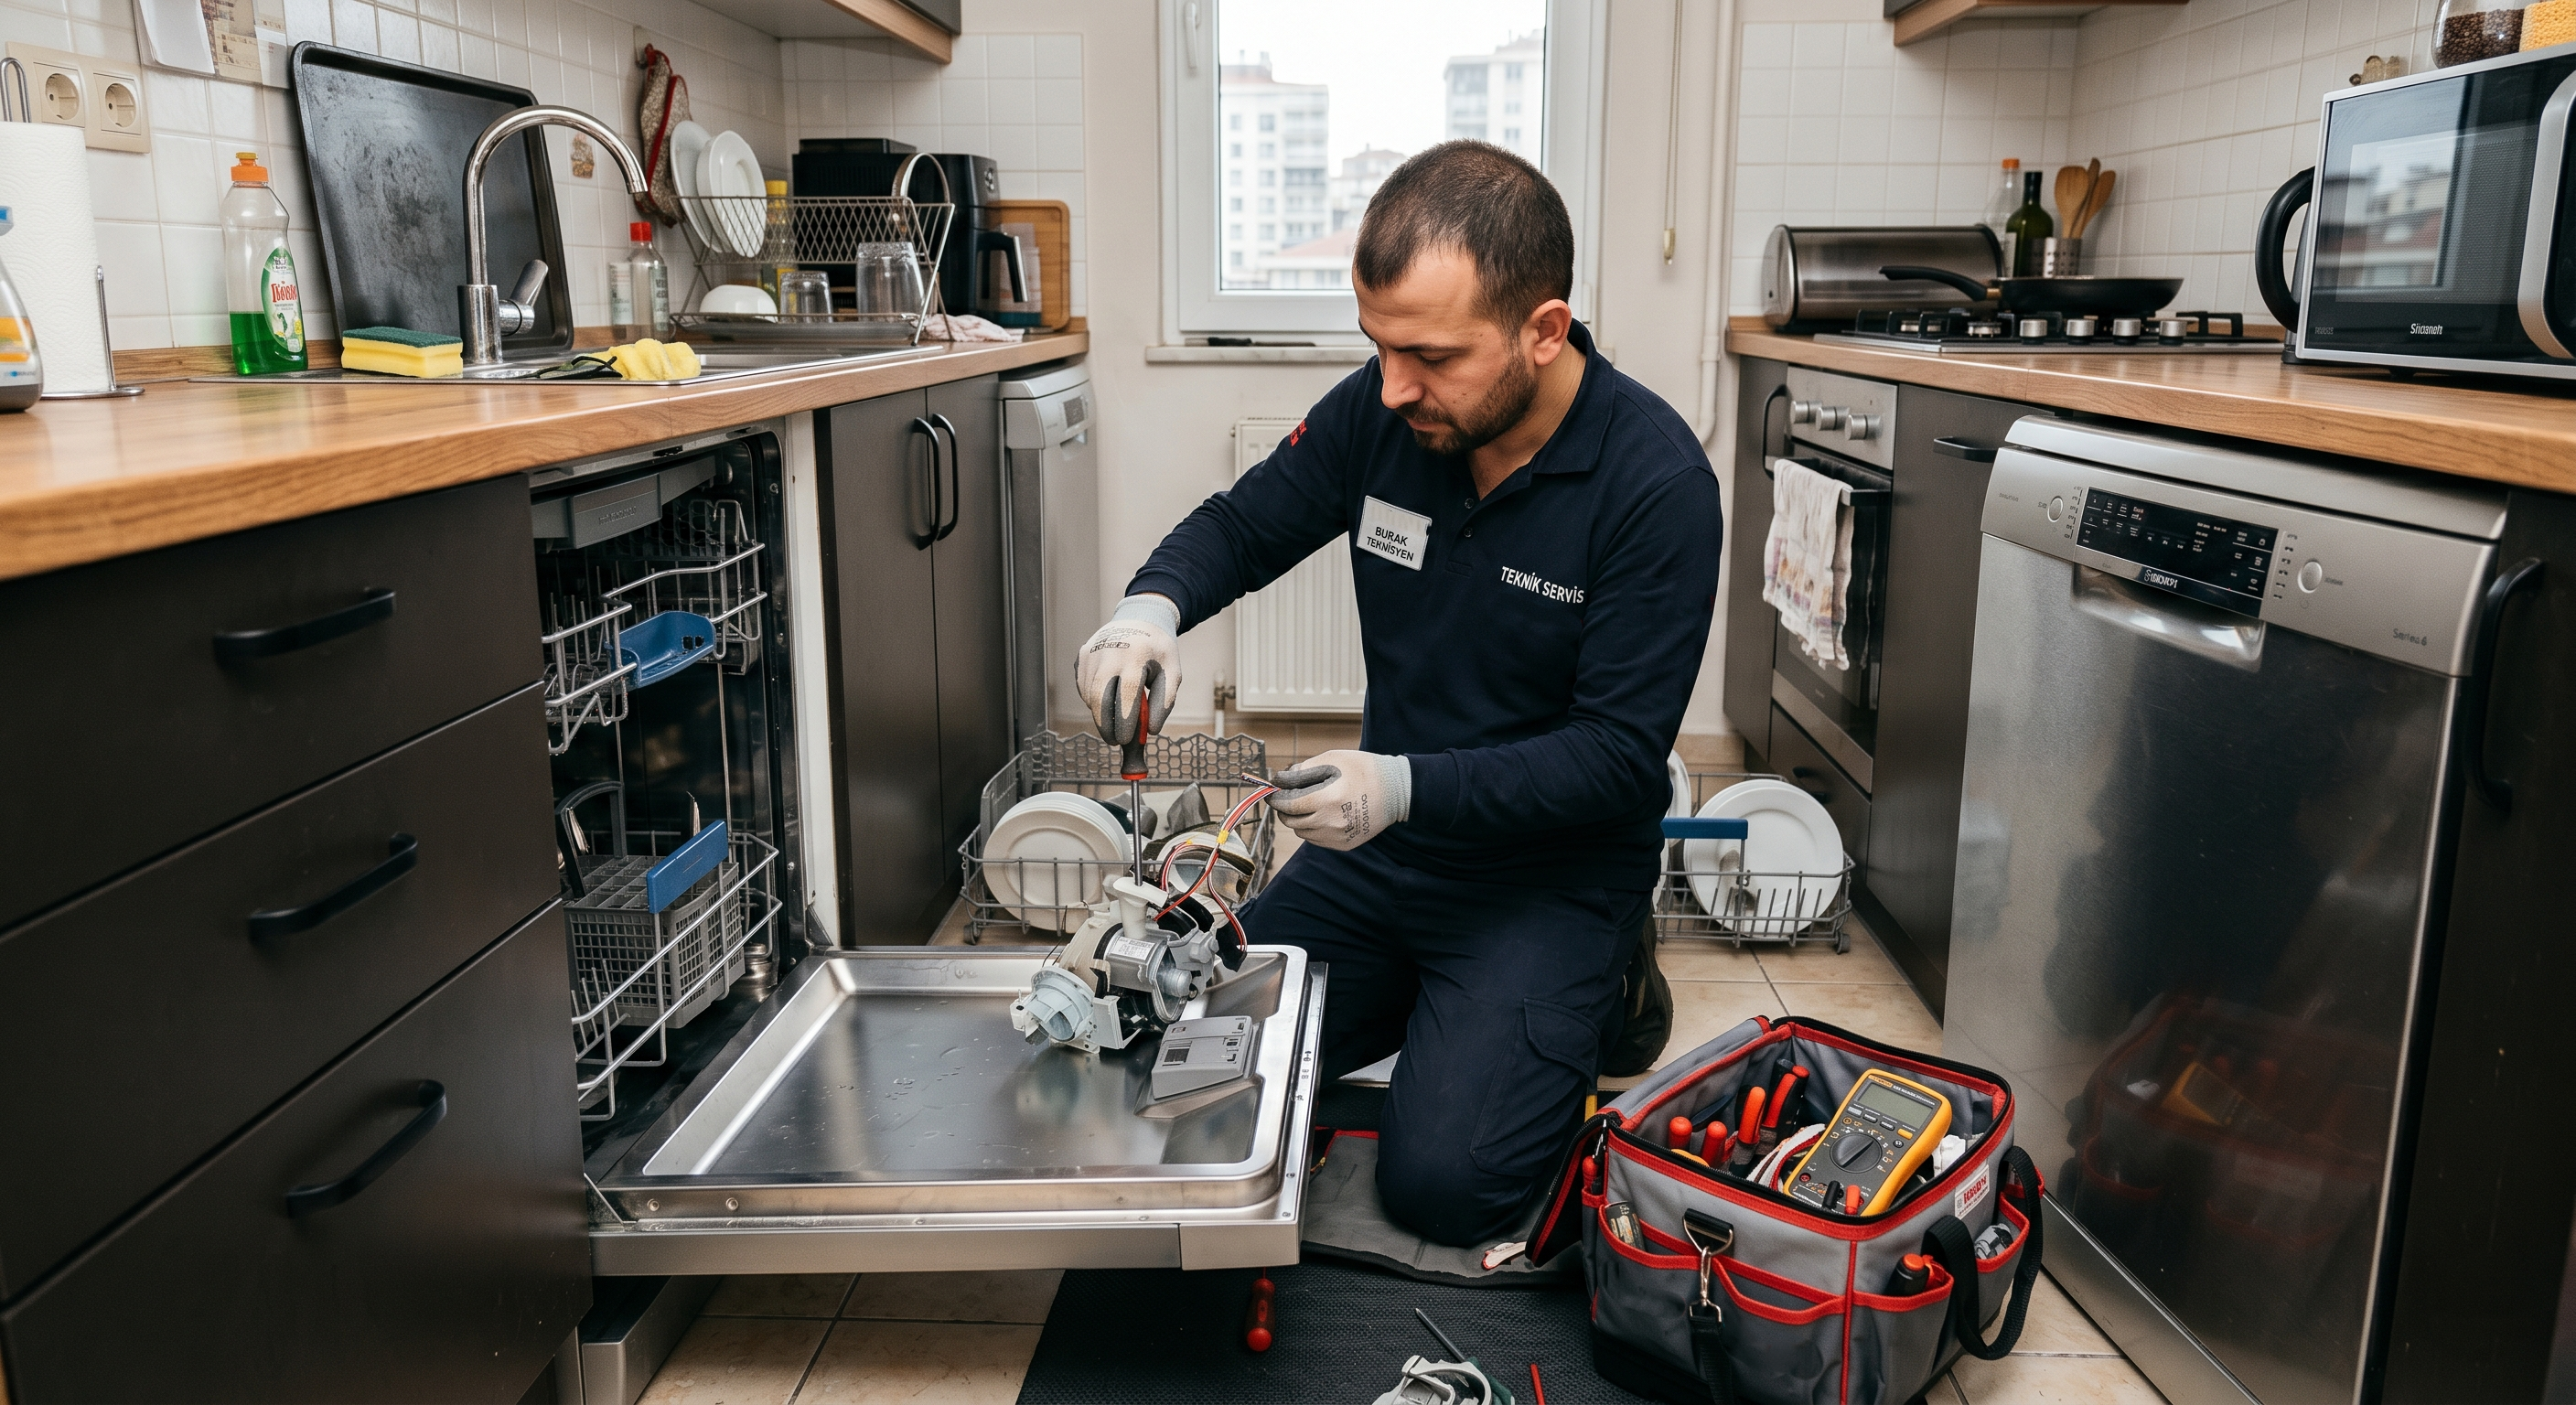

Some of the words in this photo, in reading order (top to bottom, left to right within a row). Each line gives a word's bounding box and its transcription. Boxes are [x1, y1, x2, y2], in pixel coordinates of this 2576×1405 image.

[1367, 536, 1414, 562] TEKNİSYEN
[1375, 526, 1409, 547] BURAK
[1500, 565, 1542, 594] TEKNİK
[1541, 581, 1585, 604] SERVİS
